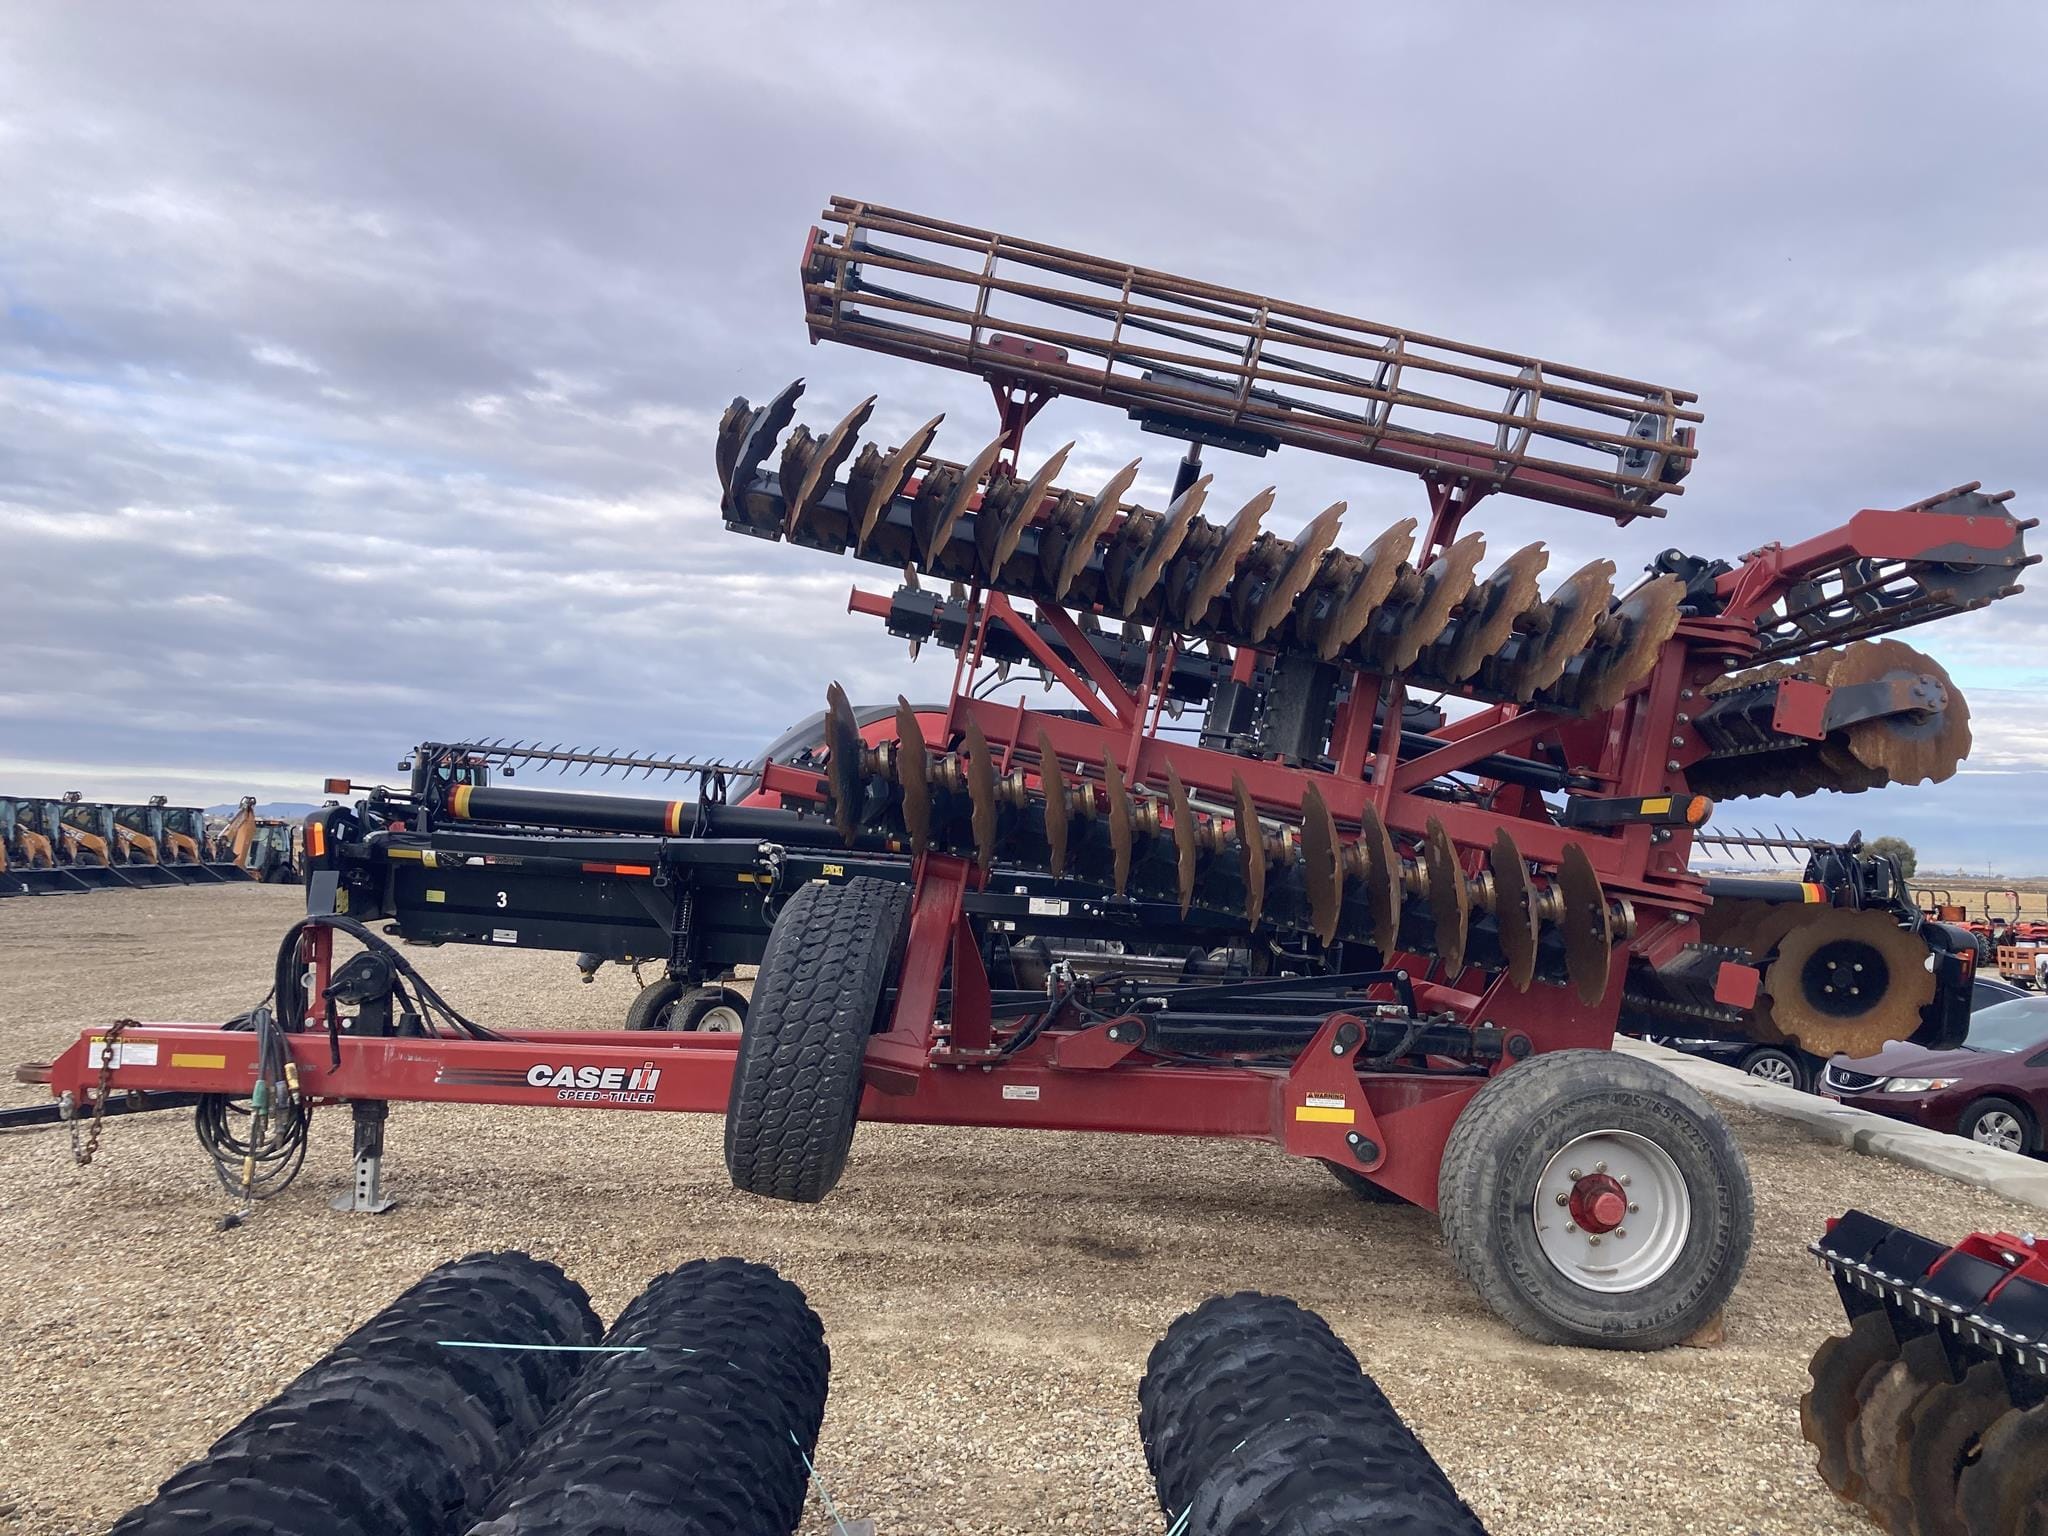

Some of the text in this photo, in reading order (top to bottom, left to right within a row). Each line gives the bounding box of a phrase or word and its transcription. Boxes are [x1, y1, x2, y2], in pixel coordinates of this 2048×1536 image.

[496, 891, 507, 908] 3
[526, 1064, 625, 1090] CASE
[558, 1089, 656, 1103] SPEED-TILLER
